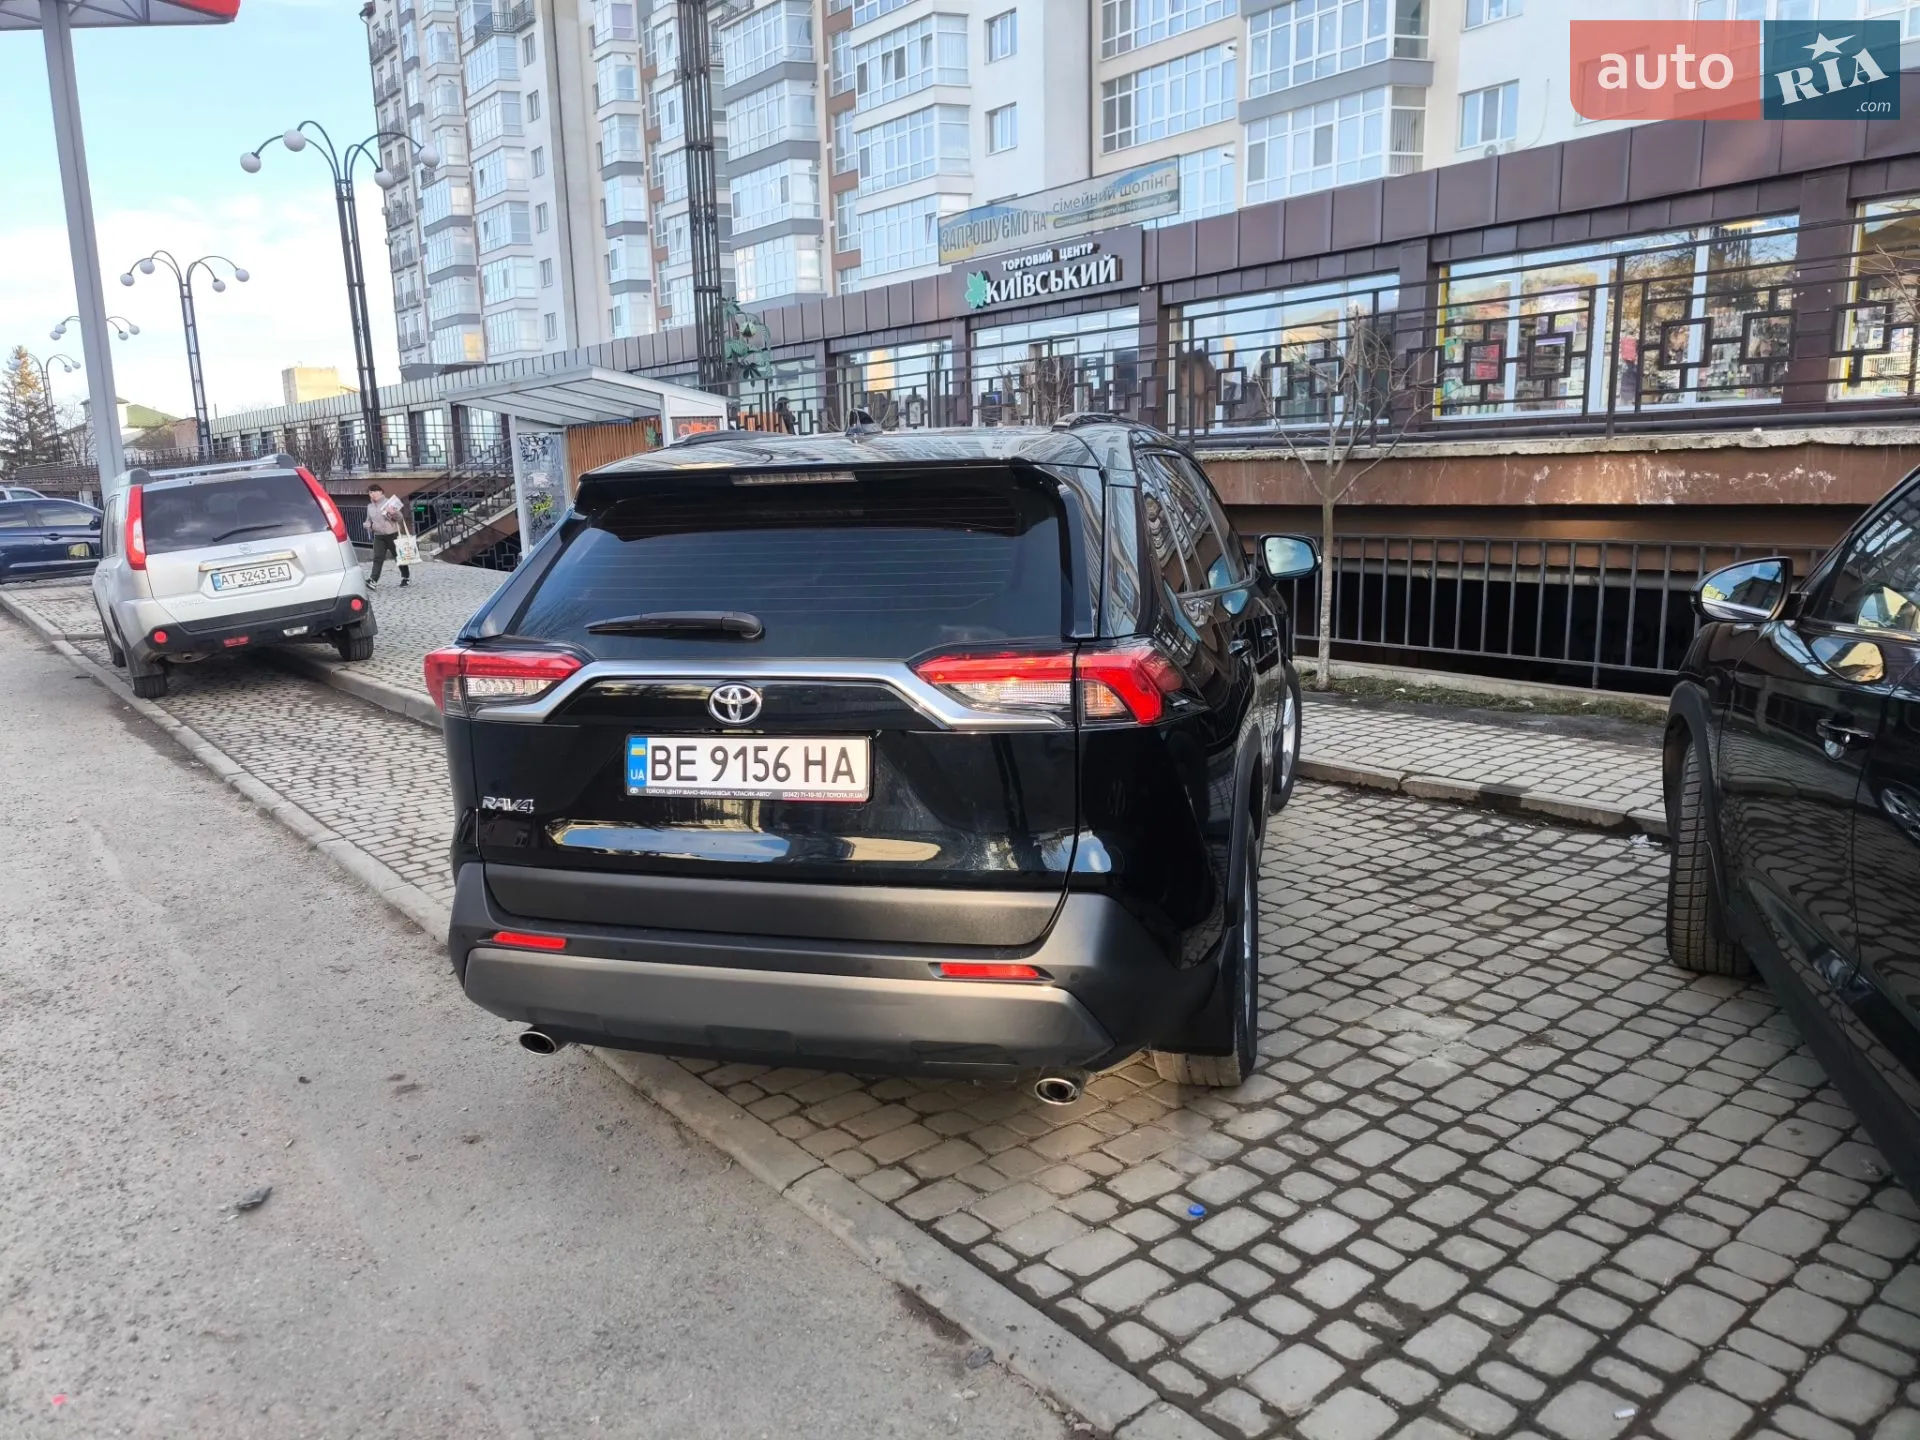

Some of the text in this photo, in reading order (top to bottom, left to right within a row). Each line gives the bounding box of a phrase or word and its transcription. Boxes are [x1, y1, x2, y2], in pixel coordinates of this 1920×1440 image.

[1052, 186, 1116, 213] сімейний
[1120, 172, 1172, 197] шопінг
[941, 212, 1029, 253] ЗАПРОШУЄМО
[1001, 242, 1094, 272] ТОРГОВИЙ ЦЕНТР
[985, 255, 1117, 304] КИЇВСЬКИЙ
[221, 574, 237, 586] AT
[240, 570, 267, 583] 3243
[268, 566, 286, 579] EA
[630, 769, 645, 781] UA
[650, 745, 856, 783] BE 9156 HA
[482, 796, 535, 814] RAV4
